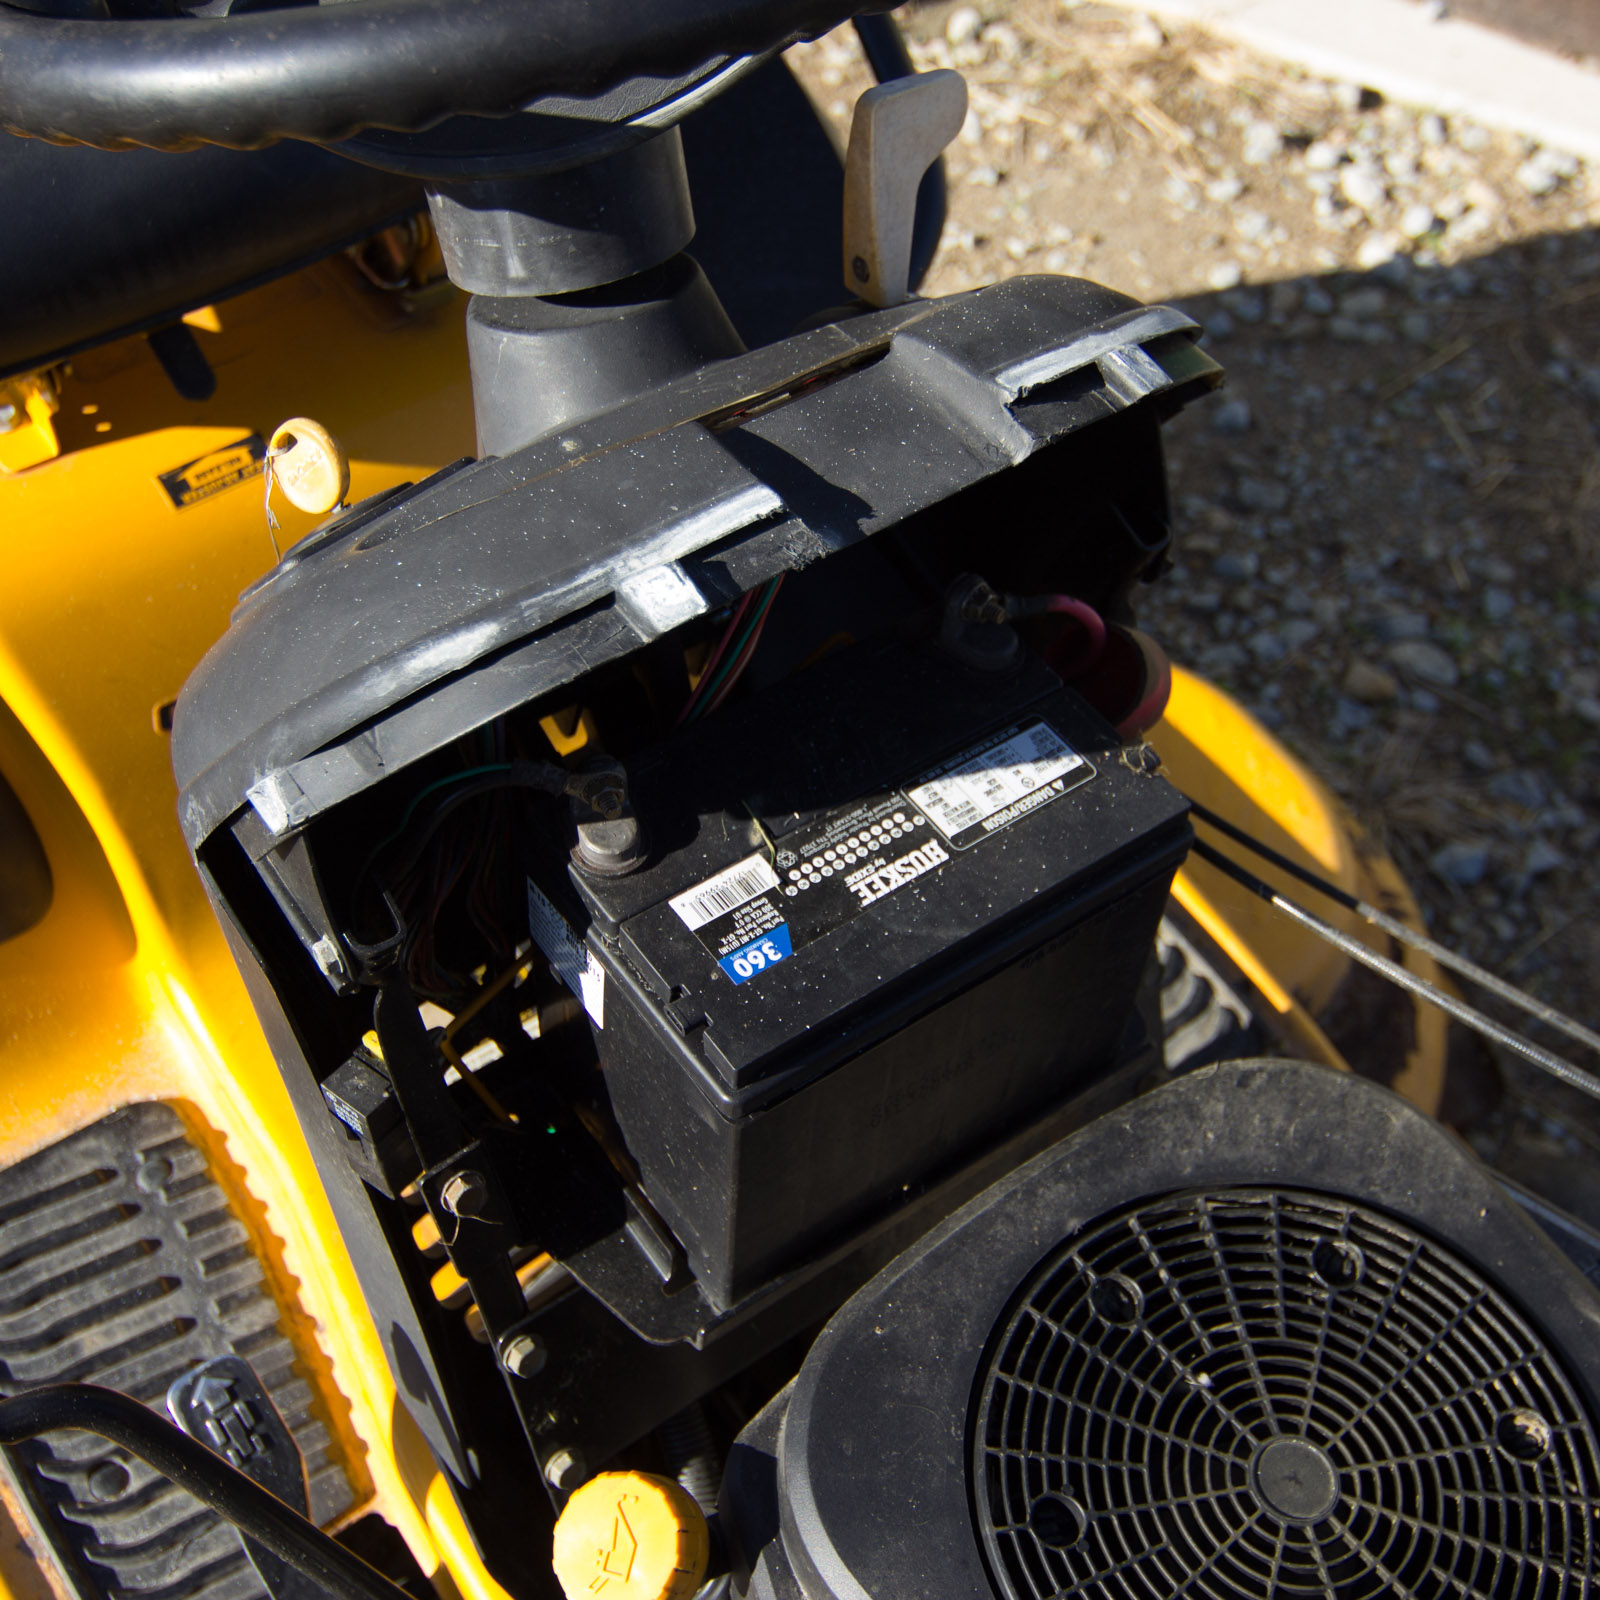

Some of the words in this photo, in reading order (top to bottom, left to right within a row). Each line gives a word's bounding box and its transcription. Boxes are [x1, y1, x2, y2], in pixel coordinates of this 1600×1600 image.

[981, 784, 1055, 831] DANGER/POISON
[801, 840, 830, 858] Company
[843, 863, 875, 886] EXIDE
[848, 838, 949, 907] HUSKEE
[740, 905, 752, 916] Size
[749, 895, 769, 910] Group
[749, 908, 762, 919] CCA
[755, 908, 779, 925] Replaces
[770, 915, 784, 926] Part
[733, 927, 745, 937] No.
[743, 920, 756, 932] Part
[720, 932, 735, 945] GT-X
[738, 926, 763, 944] GT-X-MT
[732, 940, 782, 977] 360
